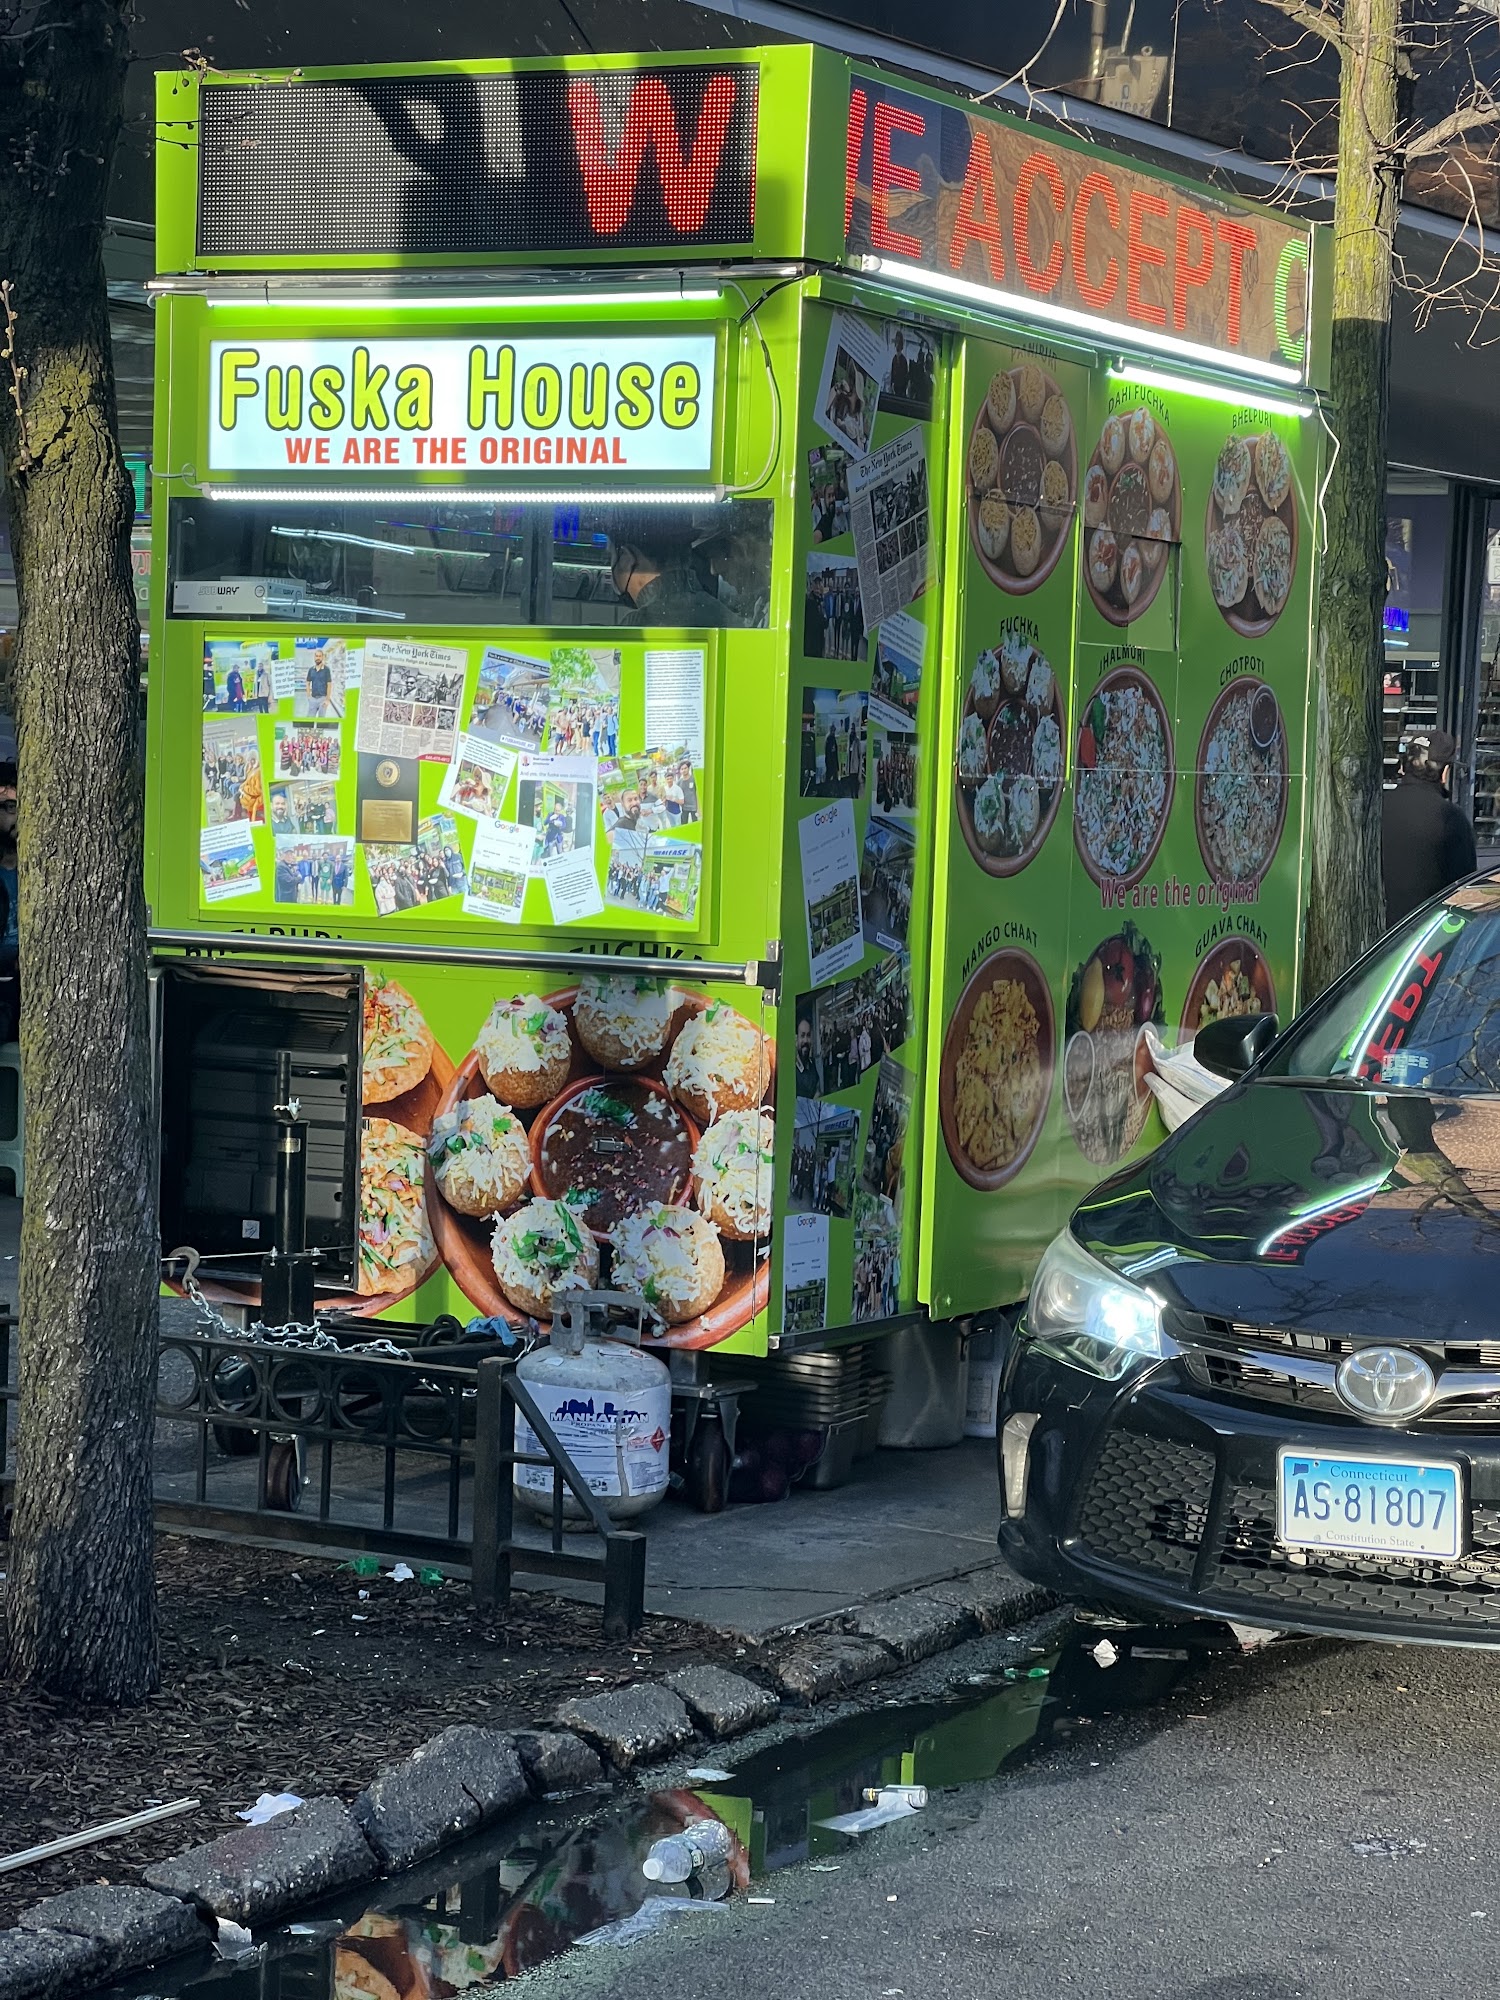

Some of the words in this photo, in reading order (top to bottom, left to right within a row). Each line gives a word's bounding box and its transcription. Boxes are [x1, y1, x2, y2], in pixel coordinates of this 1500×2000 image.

[567, 75, 738, 236] W
[949, 131, 1258, 346] ACCEPT
[218, 344, 434, 432] Fuska
[466, 343, 701, 432] House
[1108, 384, 1131, 415] DAHI
[1134, 384, 1171, 427] FUCHKA
[1232, 408, 1272, 429] BHELPURI
[284, 436, 331, 465] WE
[342, 436, 401, 464] ARE
[412, 436, 468, 465] THE
[479, 436, 628, 465] ORIGINAL
[198, 585, 240, 596] SUBWAY
[1000, 615, 1039, 642] FUCHKA
[381, 643, 395, 653] The
[396, 645, 411, 655] New
[412, 647, 429, 659] York
[430, 650, 452, 661] Times
[1219, 655, 1265, 687] CHOTPOTI
[494, 821, 520, 834] Google
[814, 806, 838, 827] Google
[1099, 877, 1126, 910] We
[1132, 882, 1159, 910] are
[1164, 875, 1191, 907] the
[1197, 875, 1261, 913] original
[1194, 915, 1234, 958] GUAVA
[1236, 913, 1268, 949] CHAAT
[961, 925, 1001, 983] MANGO
[1003, 921, 1038, 949] CHAAT
[797, 1214, 818, 1229] Google
[570, 1420, 606, 1429] PROPANE
[1330, 1464, 1409, 1483] Connecticut
[1325, 1530, 1388, 1546] Constitution
[1389, 1536, 1415, 1548] State
